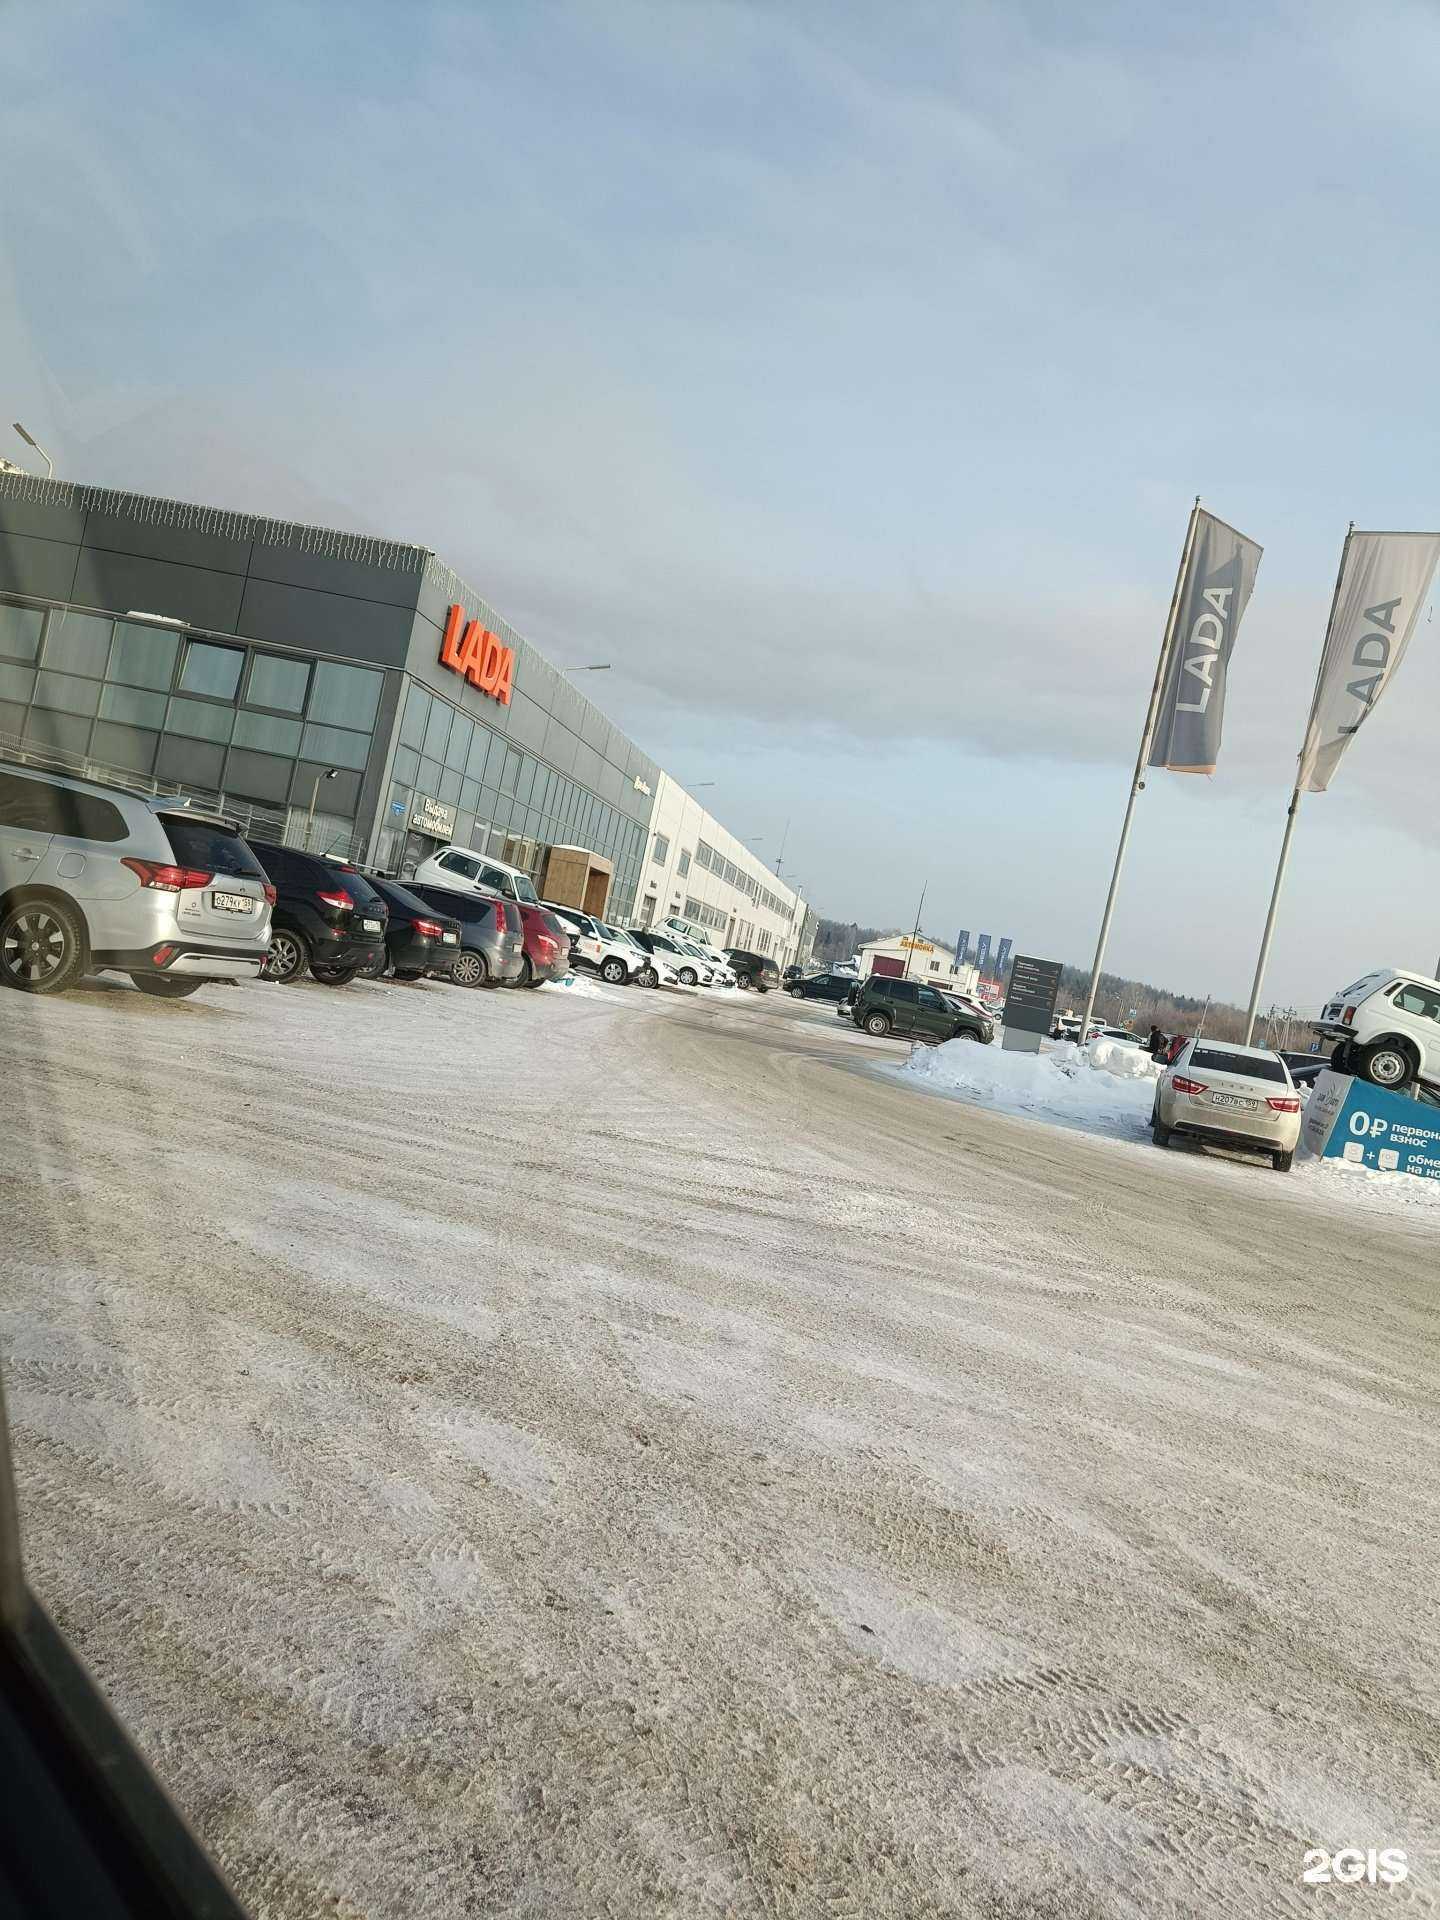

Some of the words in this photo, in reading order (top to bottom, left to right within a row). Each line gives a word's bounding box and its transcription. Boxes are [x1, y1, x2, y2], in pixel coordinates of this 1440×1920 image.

[440, 603, 515, 705] LADA
[1175, 587, 1233, 714] LADA
[1391, 1123, 1440, 1140] первон
[1390, 1133, 1428, 1148] взнос
[1406, 1164, 1422, 1175] на
